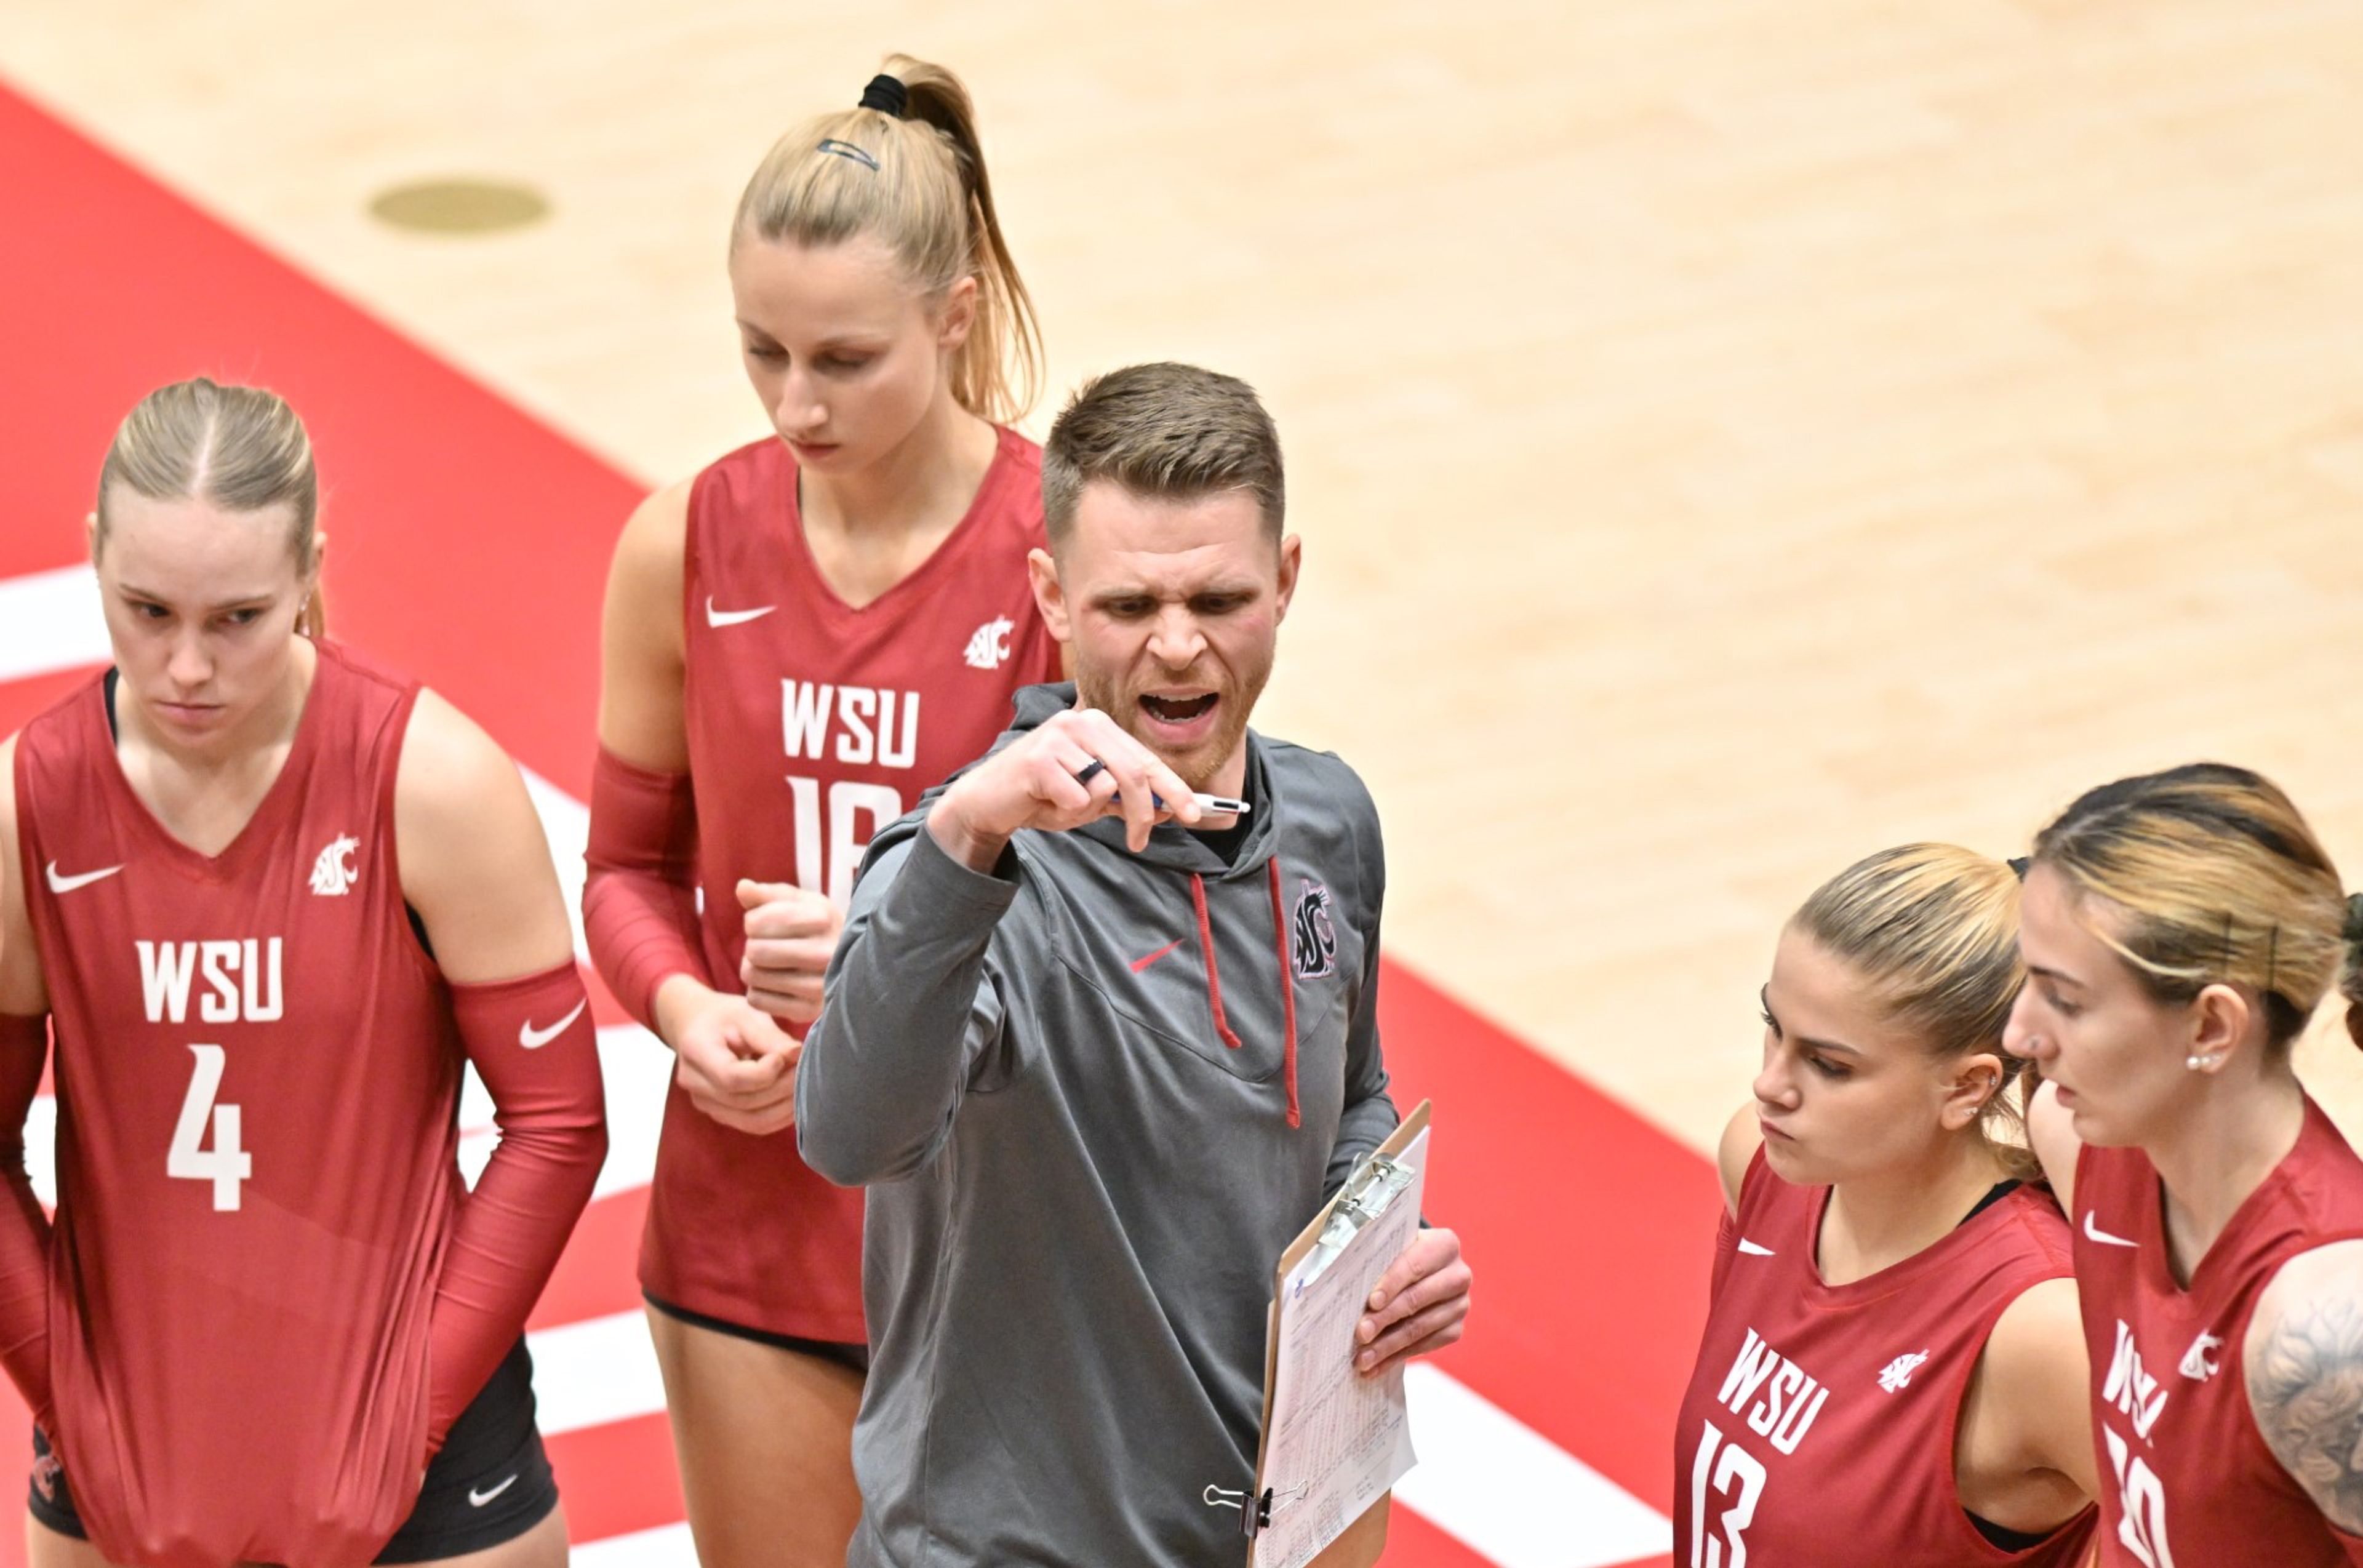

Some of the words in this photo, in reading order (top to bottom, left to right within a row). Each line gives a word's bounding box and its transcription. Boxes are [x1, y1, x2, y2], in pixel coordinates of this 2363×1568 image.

[781, 679, 920, 769] WSU
[135, 936, 283, 1023] WSU
[167, 1044, 252, 1212] 4
[1717, 1326, 1830, 1455] WSU
[1690, 1418, 1767, 1568] 13
